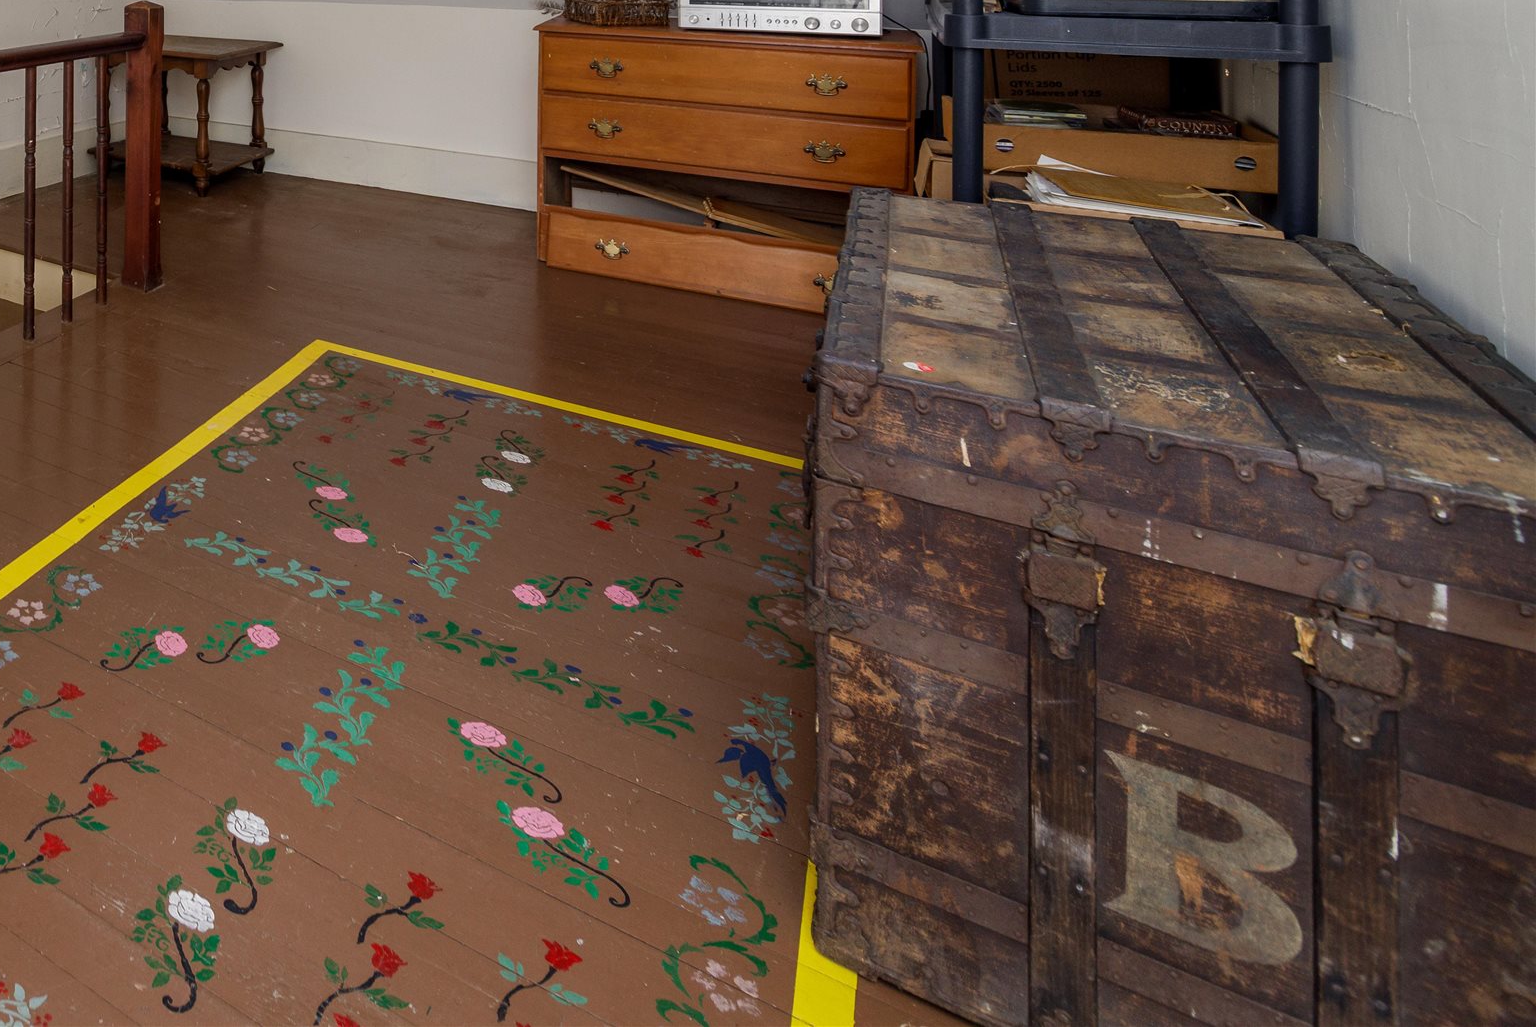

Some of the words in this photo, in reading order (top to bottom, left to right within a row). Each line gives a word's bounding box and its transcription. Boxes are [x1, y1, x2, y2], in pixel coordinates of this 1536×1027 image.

[1007, 50, 1061, 60] Portion
[1008, 62, 1037, 73] Lids
[1010, 80, 1034, 88] QTY:
[1037, 80, 1062, 88] 2500
[1025, 89, 1065, 97] Sleeves
[1068, 89, 1079, 97] of
[1081, 89, 1102, 97] 125
[1157, 120, 1231, 133] COUNTRY
[1102, 749, 1303, 965] B
